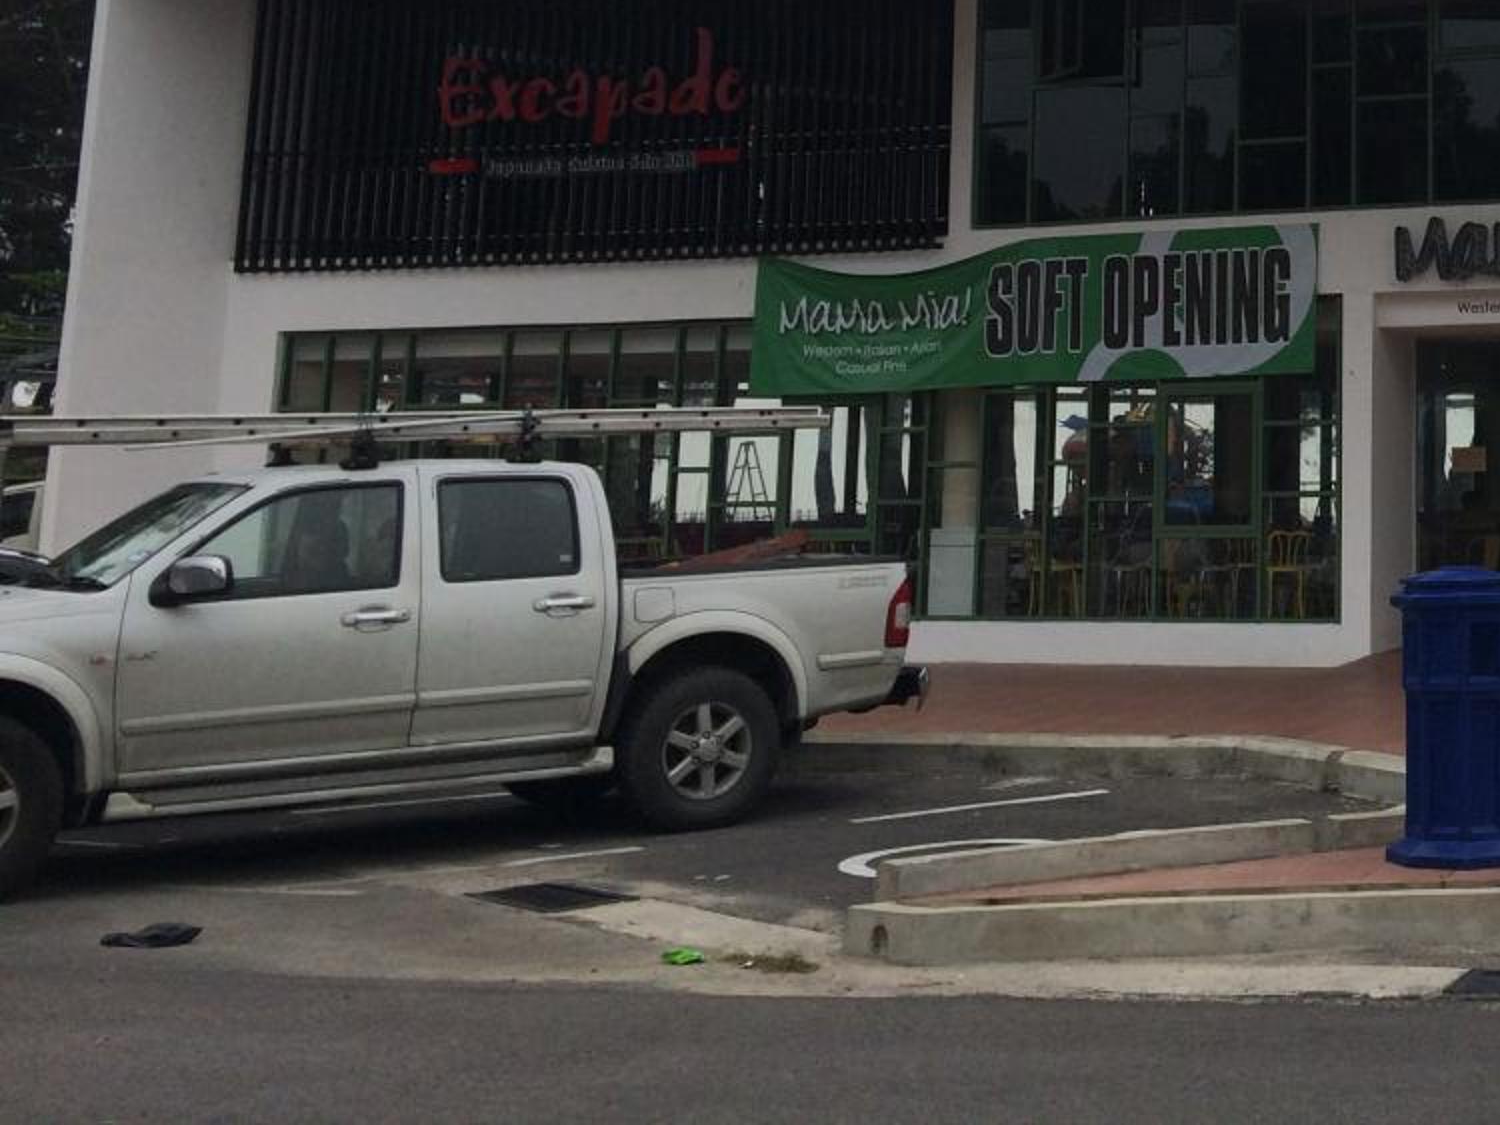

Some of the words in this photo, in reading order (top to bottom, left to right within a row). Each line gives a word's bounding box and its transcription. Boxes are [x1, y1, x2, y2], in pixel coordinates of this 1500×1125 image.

[984, 257, 1089, 357] SOFT
[1101, 246, 1292, 350] OPENING
[835, 360, 881, 375] Casual
